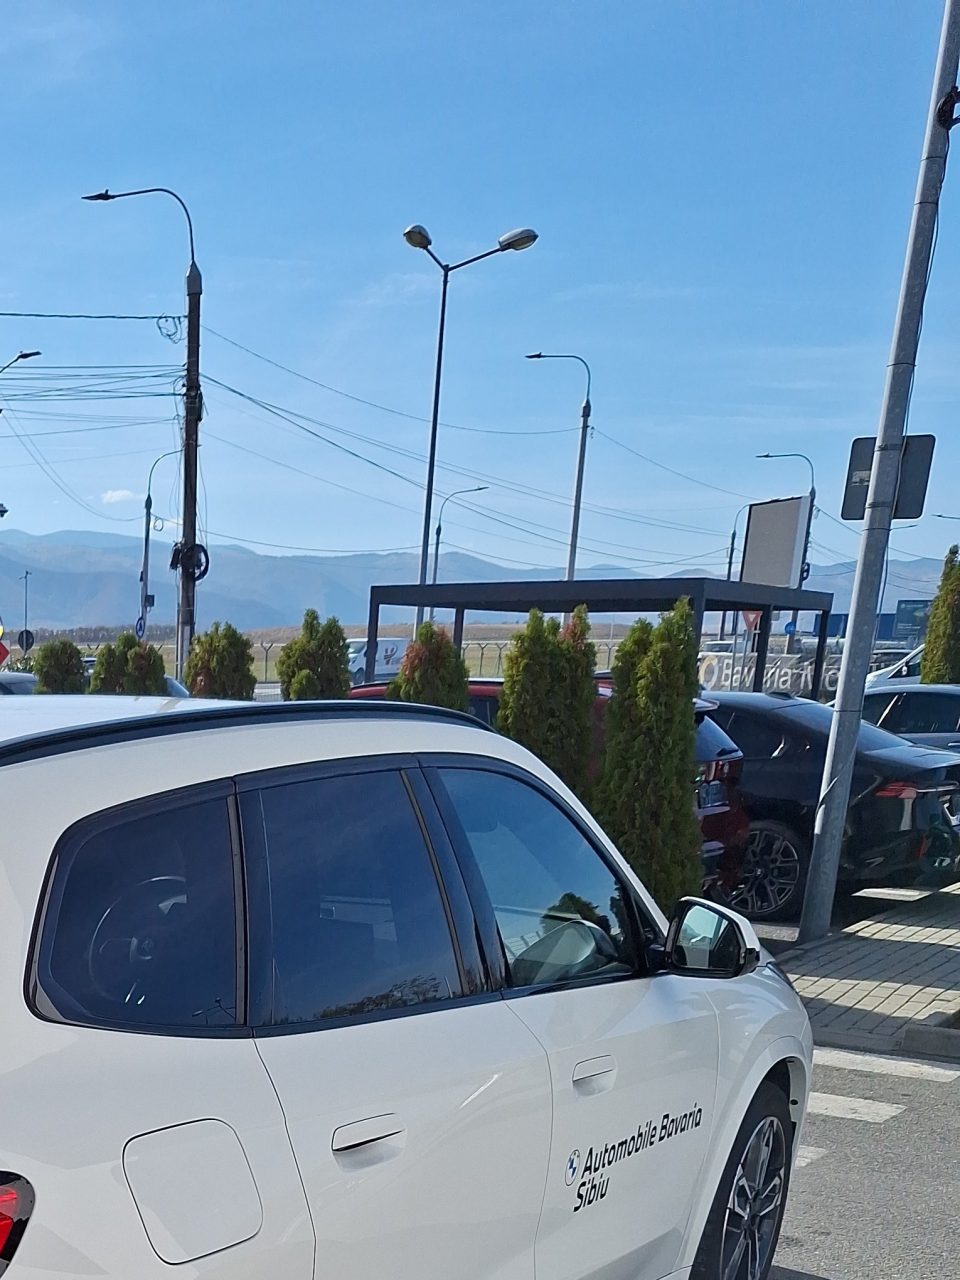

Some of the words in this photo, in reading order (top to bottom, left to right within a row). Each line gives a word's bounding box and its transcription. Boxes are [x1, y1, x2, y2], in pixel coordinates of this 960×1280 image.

[721, 658, 793, 690] Bavria
[581, 1119, 657, 1179] Automobile
[658, 1102, 703, 1142] Bavaria
[573, 1173, 610, 1213] Sibiu
